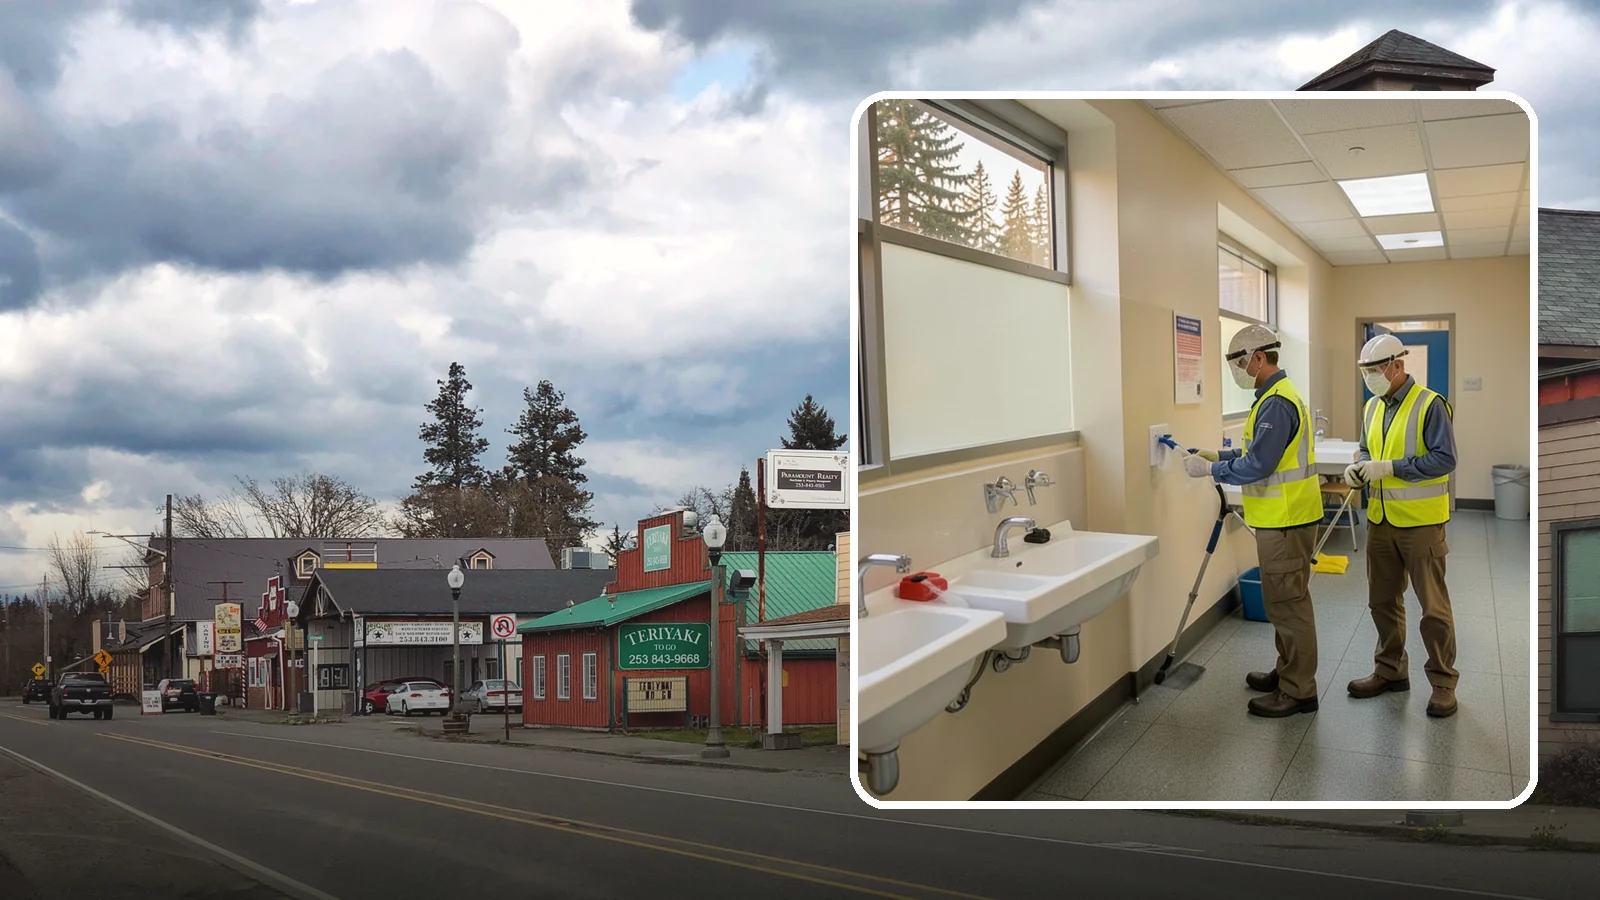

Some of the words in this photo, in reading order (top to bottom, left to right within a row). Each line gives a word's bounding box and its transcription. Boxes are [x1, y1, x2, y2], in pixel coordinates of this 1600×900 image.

[781, 471, 815, 479] PARAMOUNT
[817, 472, 839, 480] REALTY
[625, 627, 702, 646] TERIYAKI
[628, 654, 649, 665] 253
[651, 653, 700, 664] 843-9668
